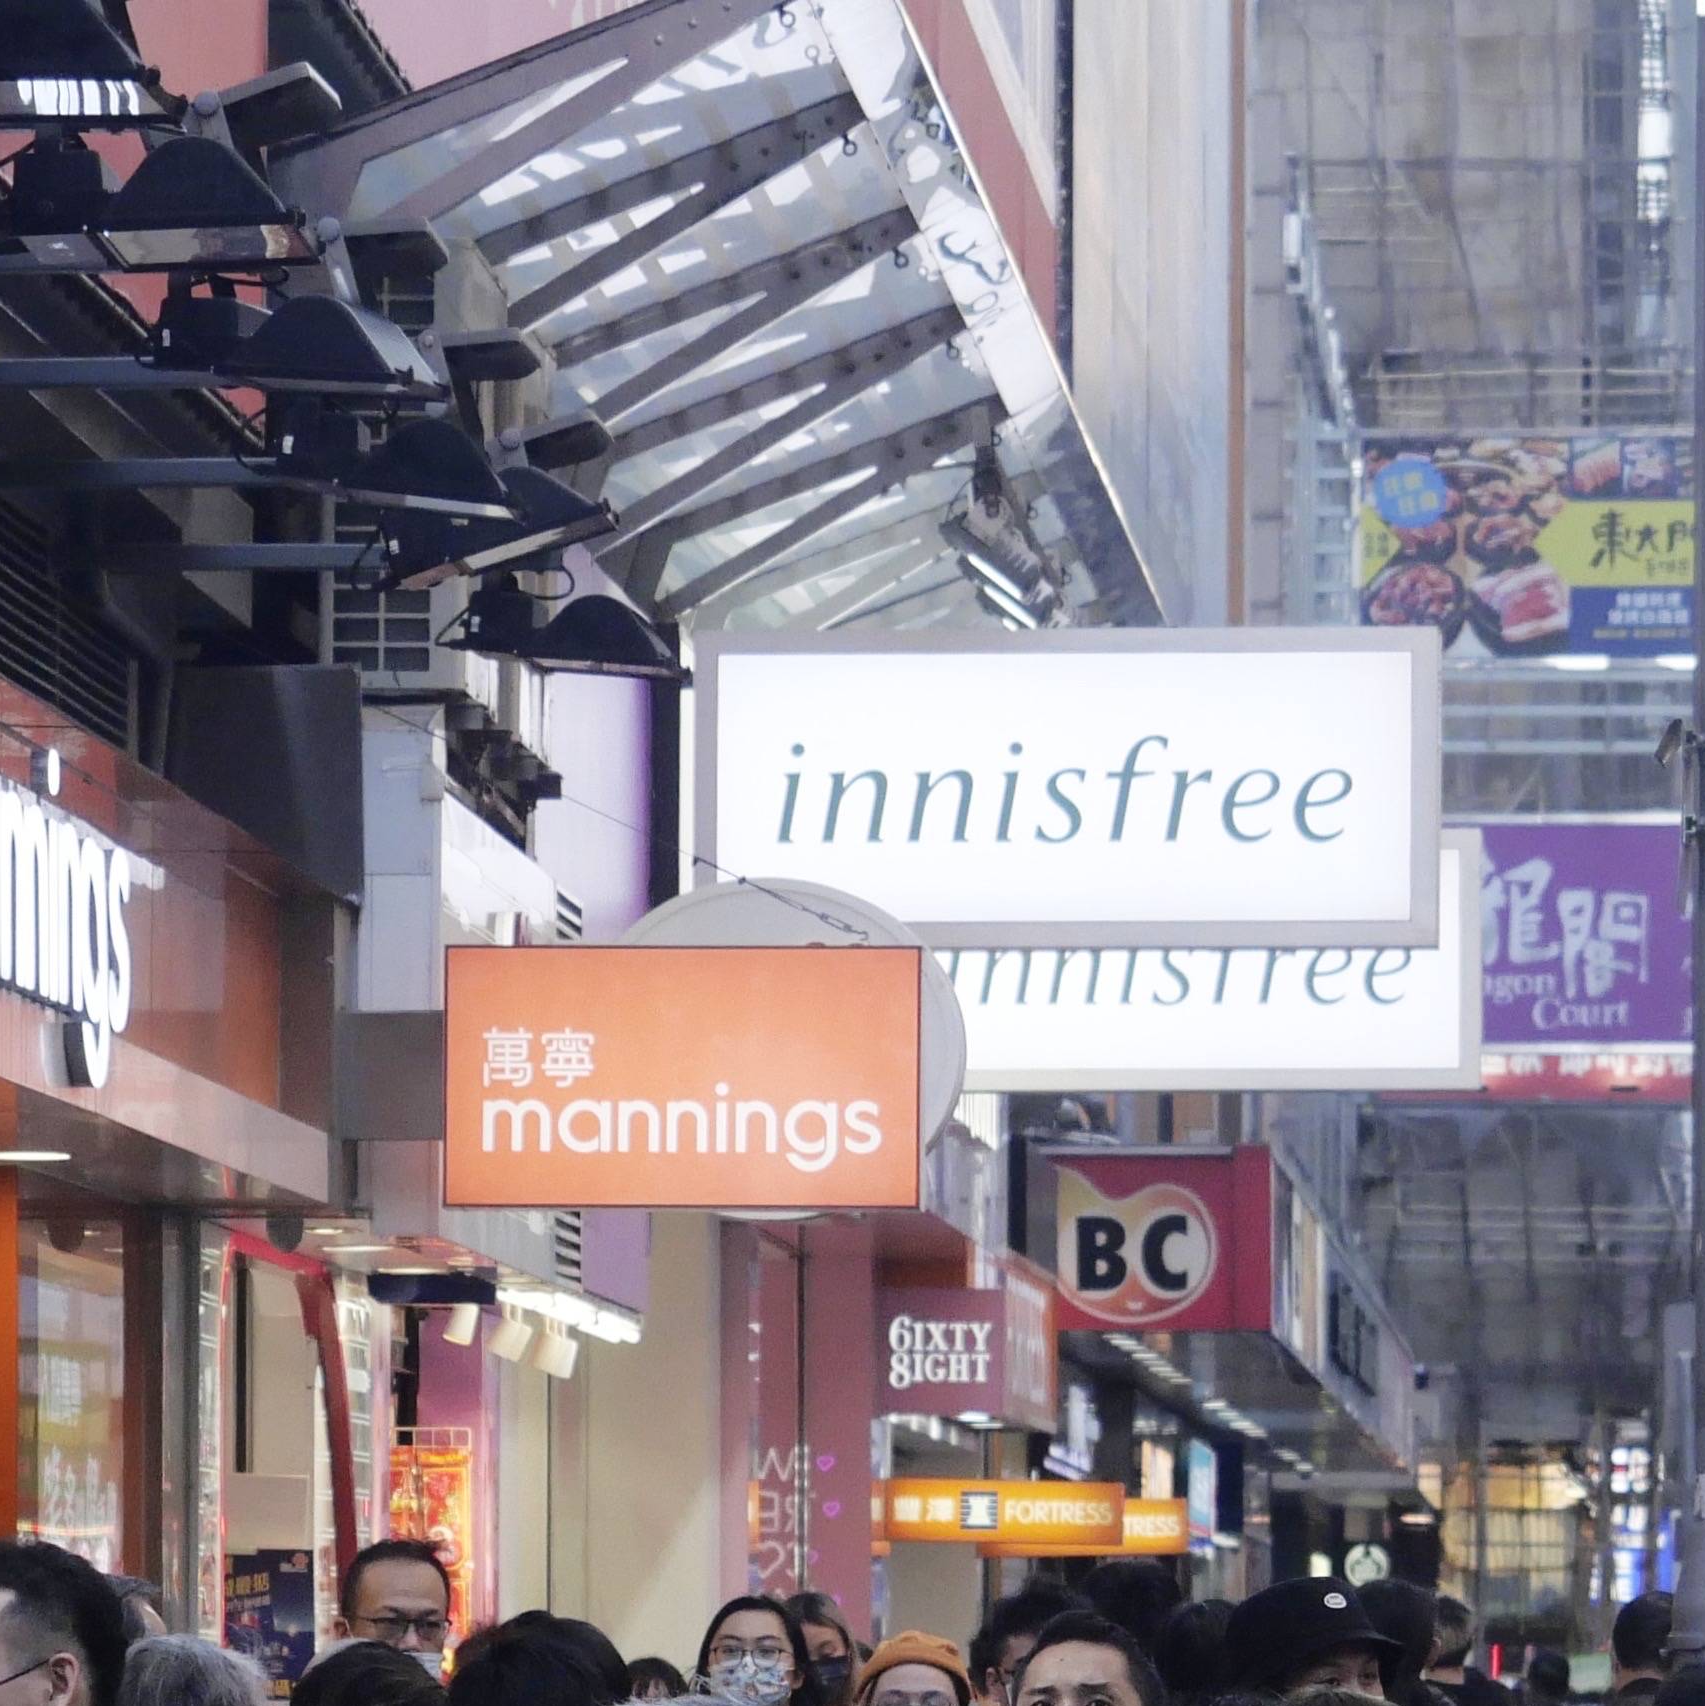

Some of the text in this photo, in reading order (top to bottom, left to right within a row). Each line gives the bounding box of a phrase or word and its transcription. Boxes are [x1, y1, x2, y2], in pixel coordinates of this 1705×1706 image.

[776, 734, 1354, 844] innisfree
[1531, 998, 1630, 1031] Court
[481, 1026, 596, 1090] 萬寧
[481, 1082, 882, 1172] mannings
[1075, 1213, 1189, 1293] BC
[888, 1315, 993, 1352] 6IXTY
[888, 1352, 991, 1389] 8IGHT
[1003, 1498, 1113, 1526] FORTRESS
[1124, 1514, 1181, 1539] TRESS
